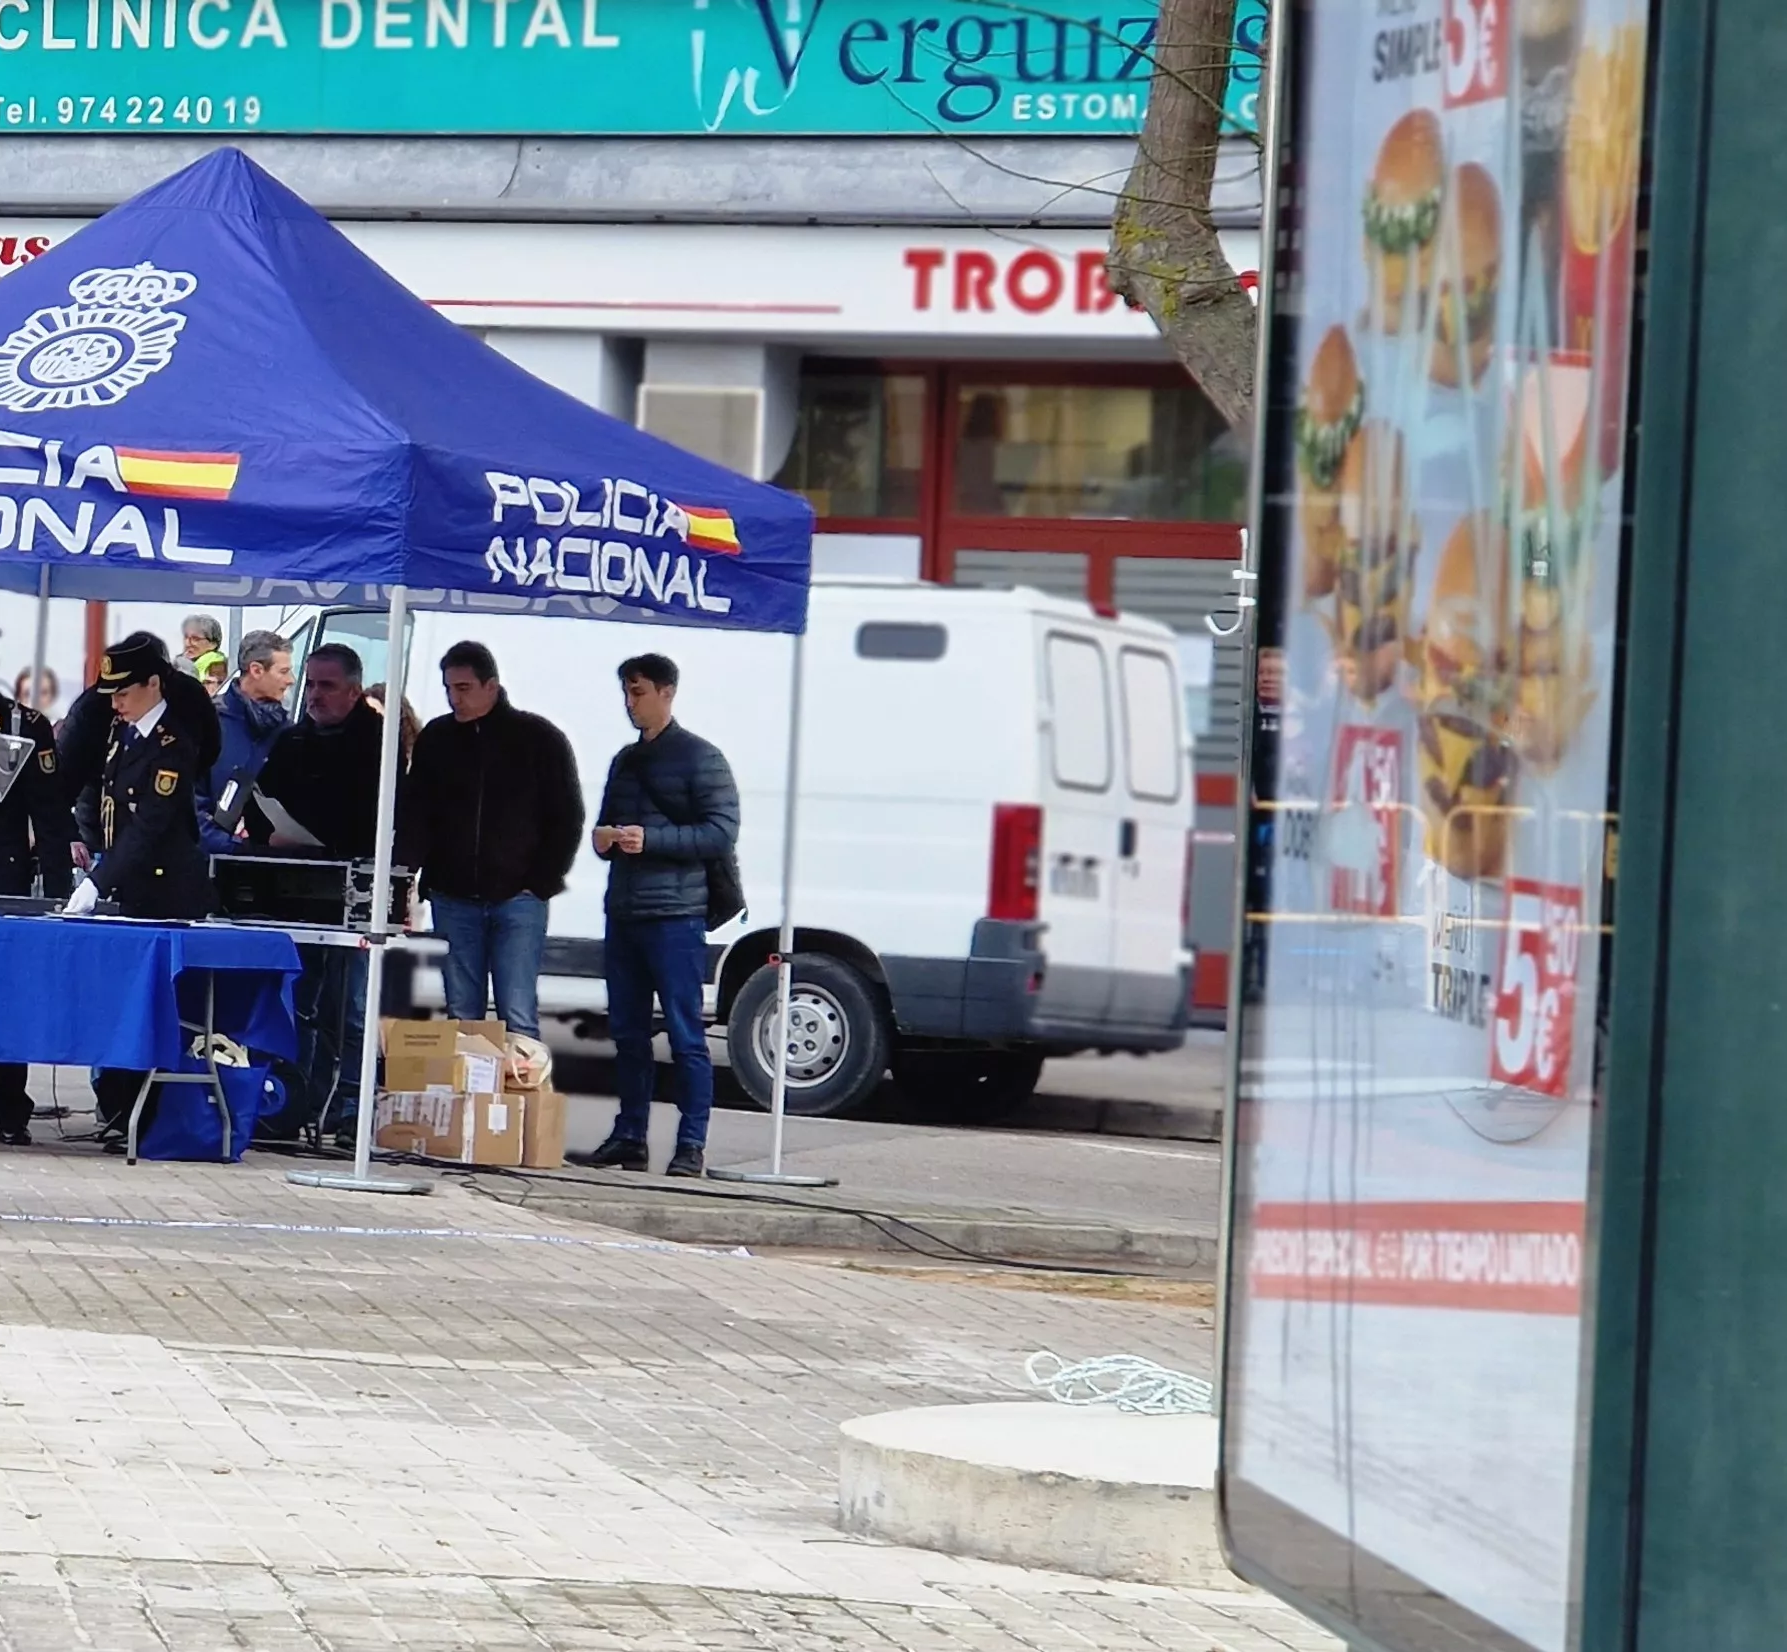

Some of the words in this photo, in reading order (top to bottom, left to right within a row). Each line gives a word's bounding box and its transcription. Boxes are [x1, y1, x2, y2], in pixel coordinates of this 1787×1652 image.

[320, 0, 620, 49] DENTAL
[903, 249, 1144, 312] TROB
[484, 471, 688, 543] POLICIA
[485, 535, 732, 613] NACIONAL
[1435, 1231, 1498, 1285] TIEMPO
[1499, 1232, 1580, 1287] LIMITADO
